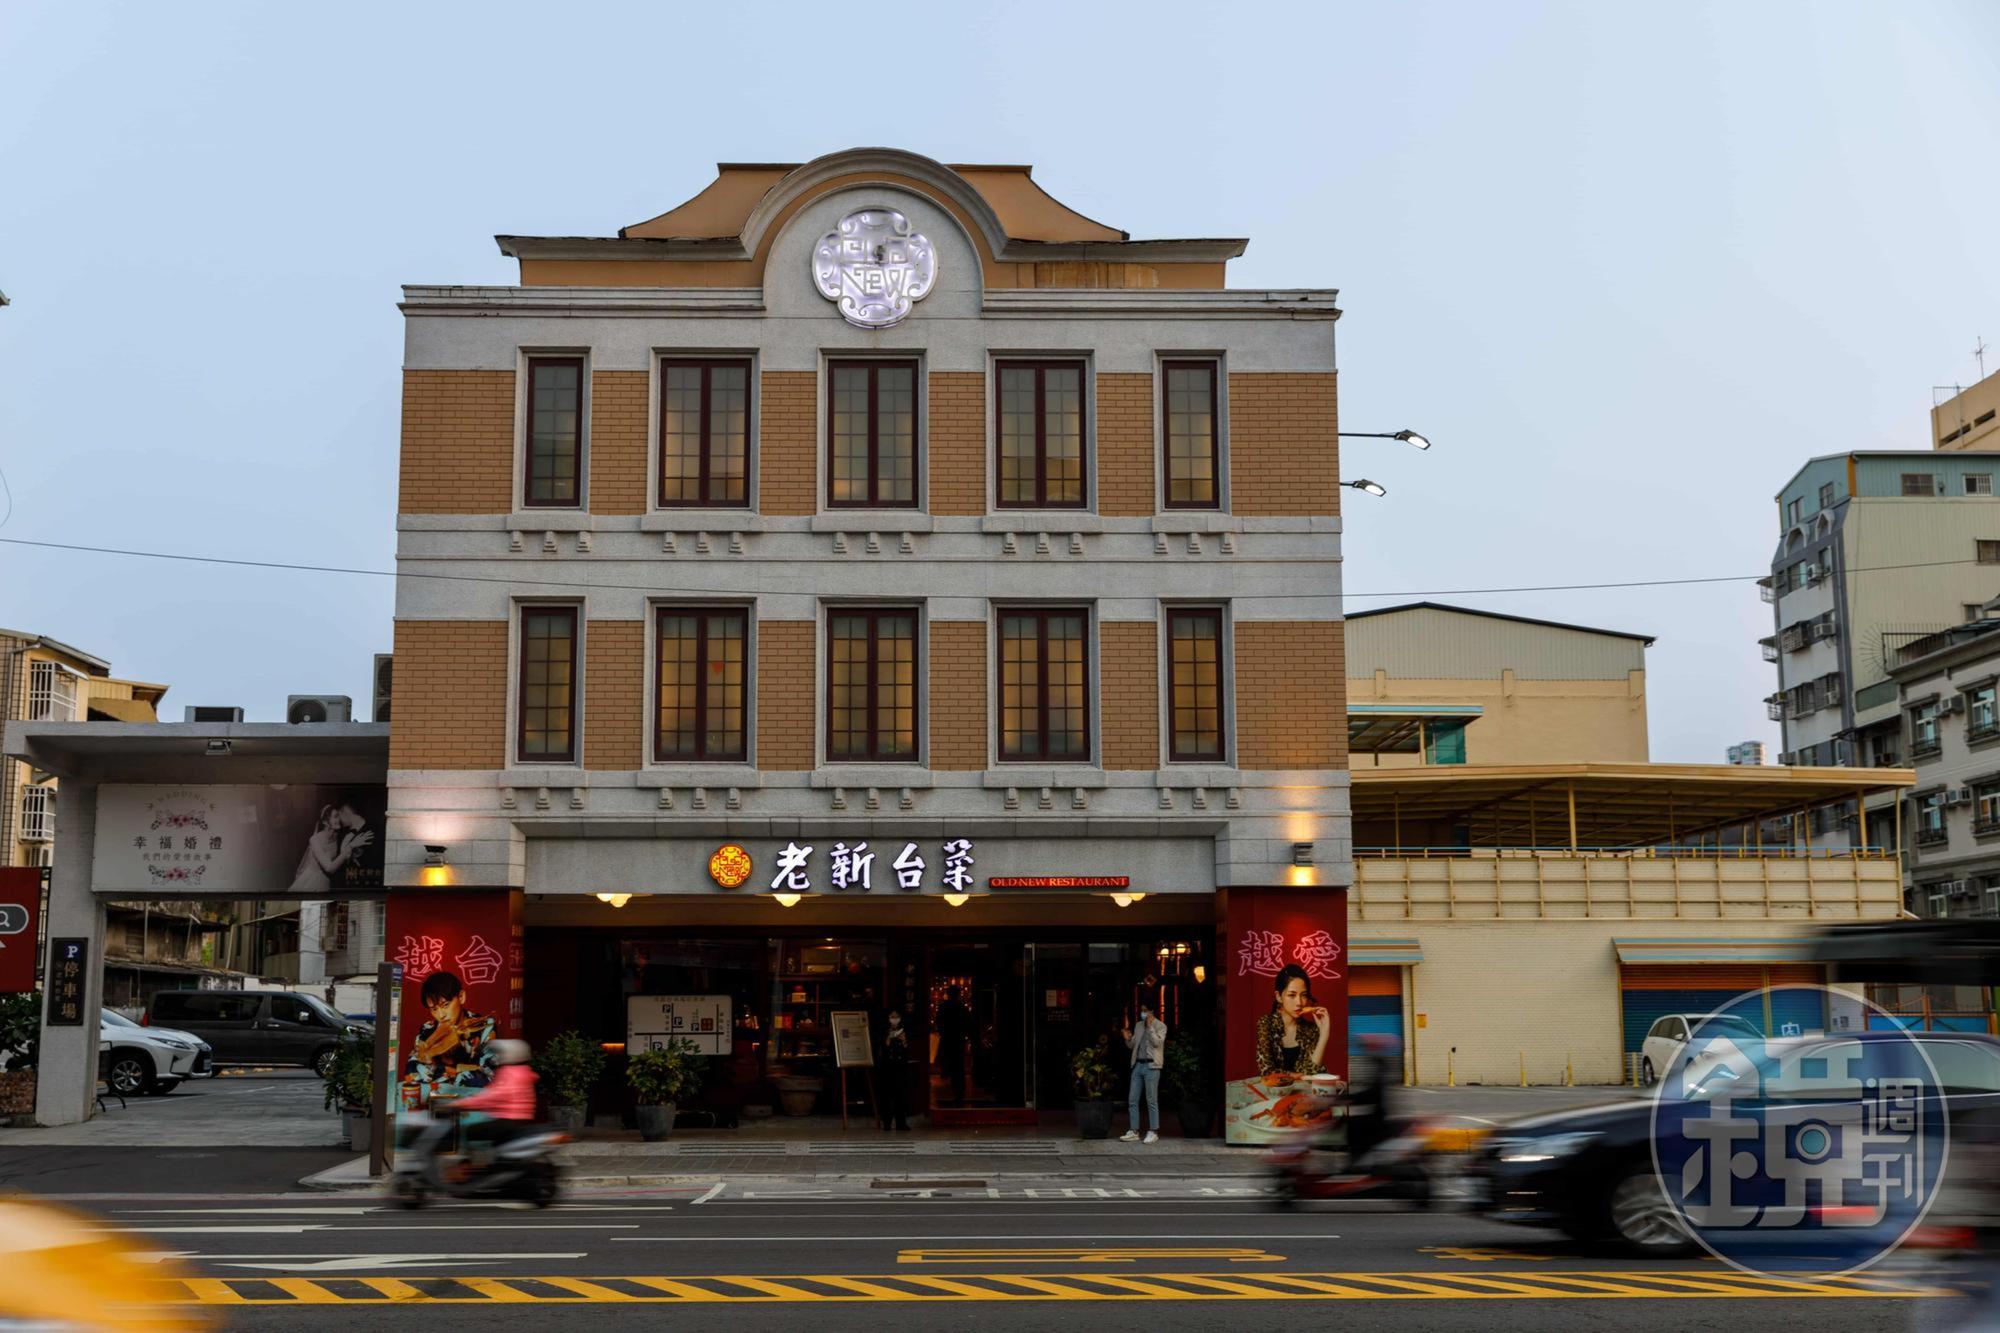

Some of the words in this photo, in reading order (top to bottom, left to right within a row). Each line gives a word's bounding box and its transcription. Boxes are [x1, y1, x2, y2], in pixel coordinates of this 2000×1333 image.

[133, 835, 223, 850] 幸福婚禮
[771, 838, 976, 892] 老新台菜
[991, 877, 1017, 887] OLD
[1019, 877, 1047, 887] NEW
[1049, 877, 1129, 887] RESTAURANT
[67, 945, 79, 958] P
[394, 935, 503, 986] 越台
[1238, 930, 1341, 979] 越愛
[61, 960, 80, 1020] 停車場
